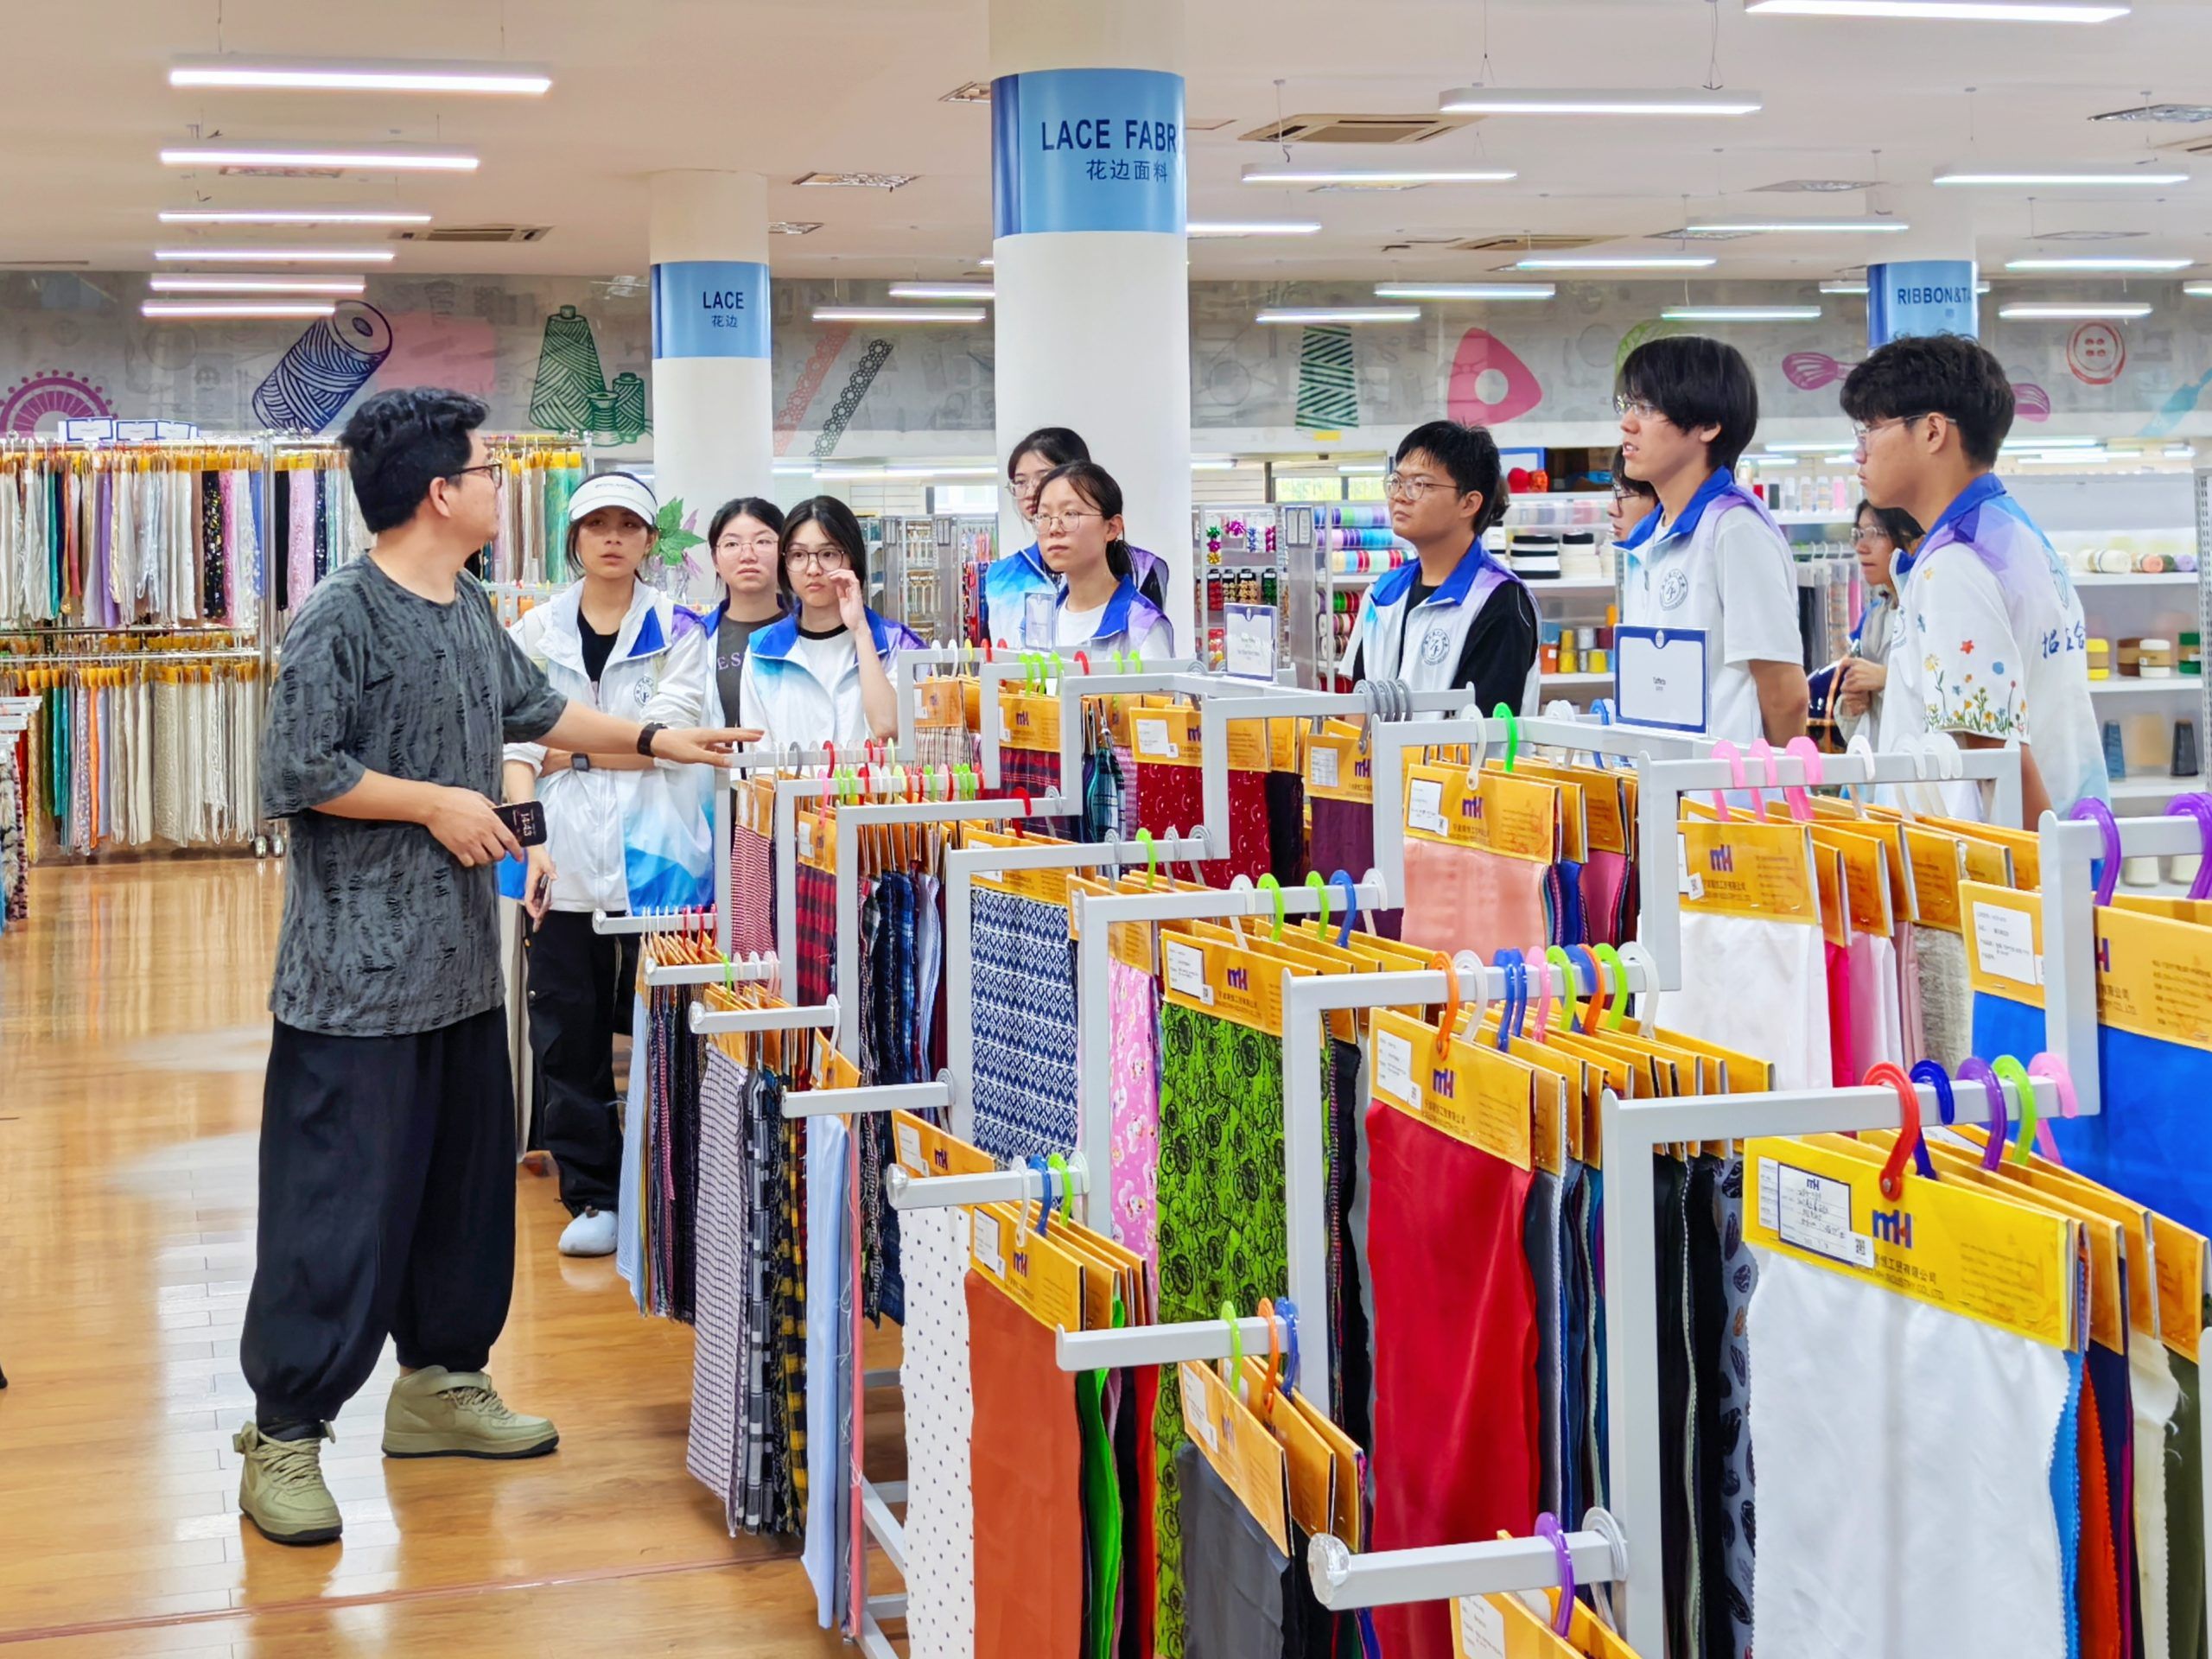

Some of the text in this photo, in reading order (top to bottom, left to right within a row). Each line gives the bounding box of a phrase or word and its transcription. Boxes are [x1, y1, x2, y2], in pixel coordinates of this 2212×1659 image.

[1041, 118, 1111, 151] LACE
[1086, 159, 1168, 183] 花边面料
[702, 291, 744, 309] LACE
[712, 315, 738, 327] 花边
